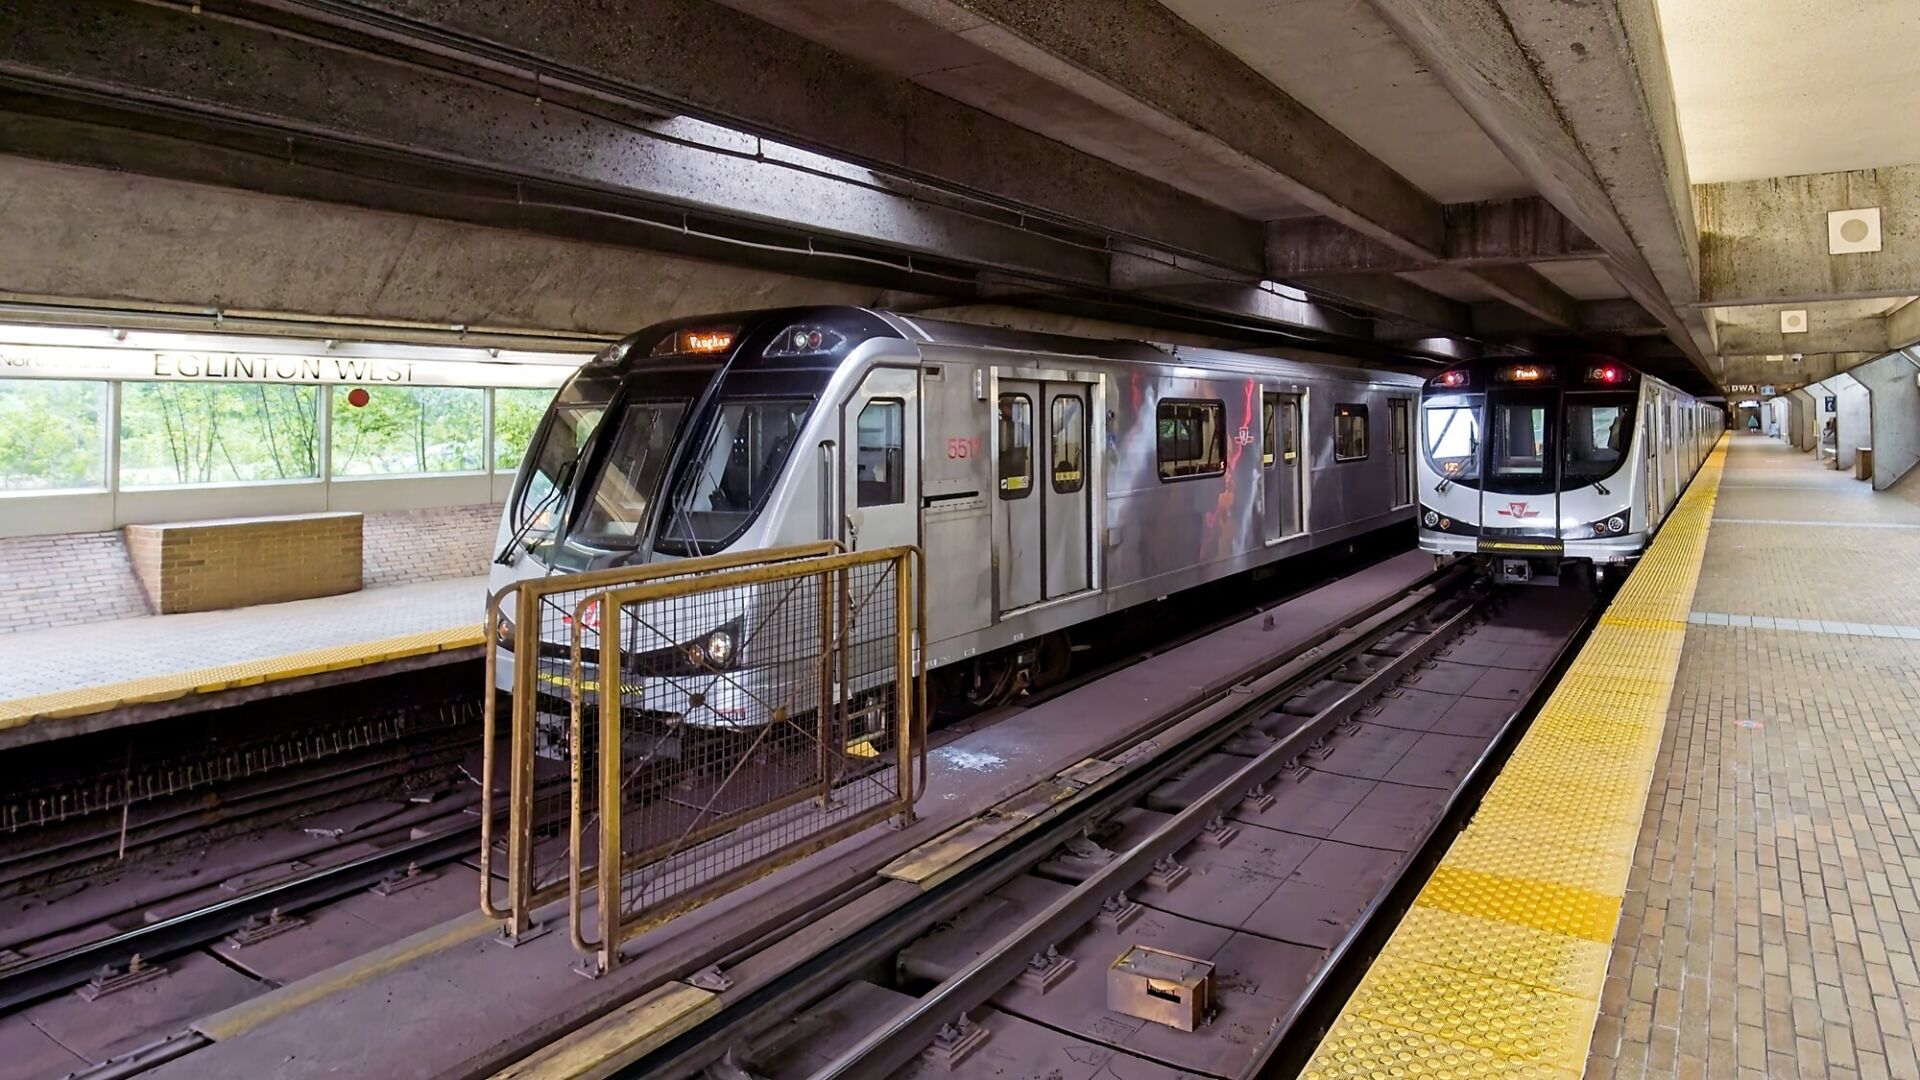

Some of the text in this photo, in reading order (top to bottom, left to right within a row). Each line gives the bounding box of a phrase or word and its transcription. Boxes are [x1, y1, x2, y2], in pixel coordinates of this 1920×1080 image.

[689, 335, 731, 350] Vaughan
[153, 353, 417, 382] EGLINTON WEST
[1516, 369, 1538, 378] Finch
